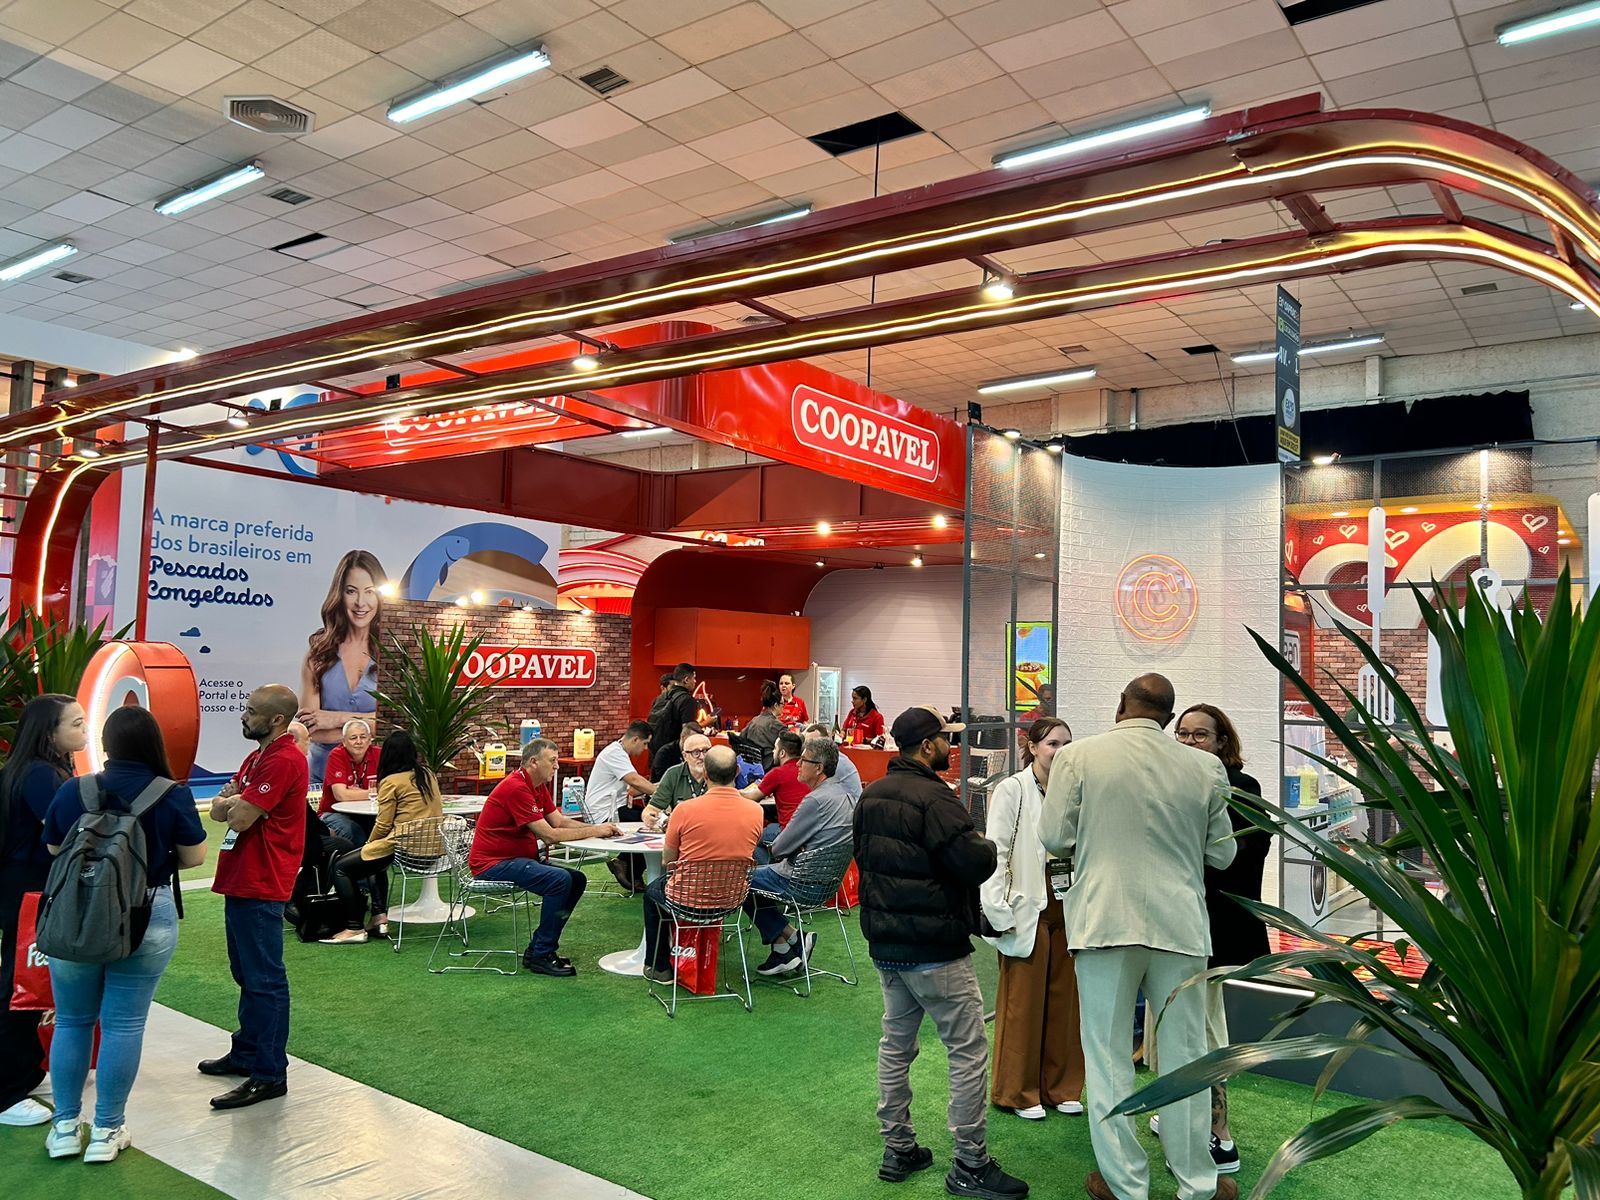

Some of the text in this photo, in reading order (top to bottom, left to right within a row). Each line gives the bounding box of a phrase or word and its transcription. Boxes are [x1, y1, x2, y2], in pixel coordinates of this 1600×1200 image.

[800, 398, 935, 471] COOPAVEL
[152, 507, 314, 543] A marca preferida
[151, 530, 312, 564] dos brasileiros em
[149, 555, 249, 582] Pescados
[147, 579, 274, 608] Congelados
[448, 651, 593, 679] OOPAVEL
[199, 678, 244, 688] Acesse o
[199, 689, 250, 700] Portal e ba
[228, 702, 247, 712] e-b
